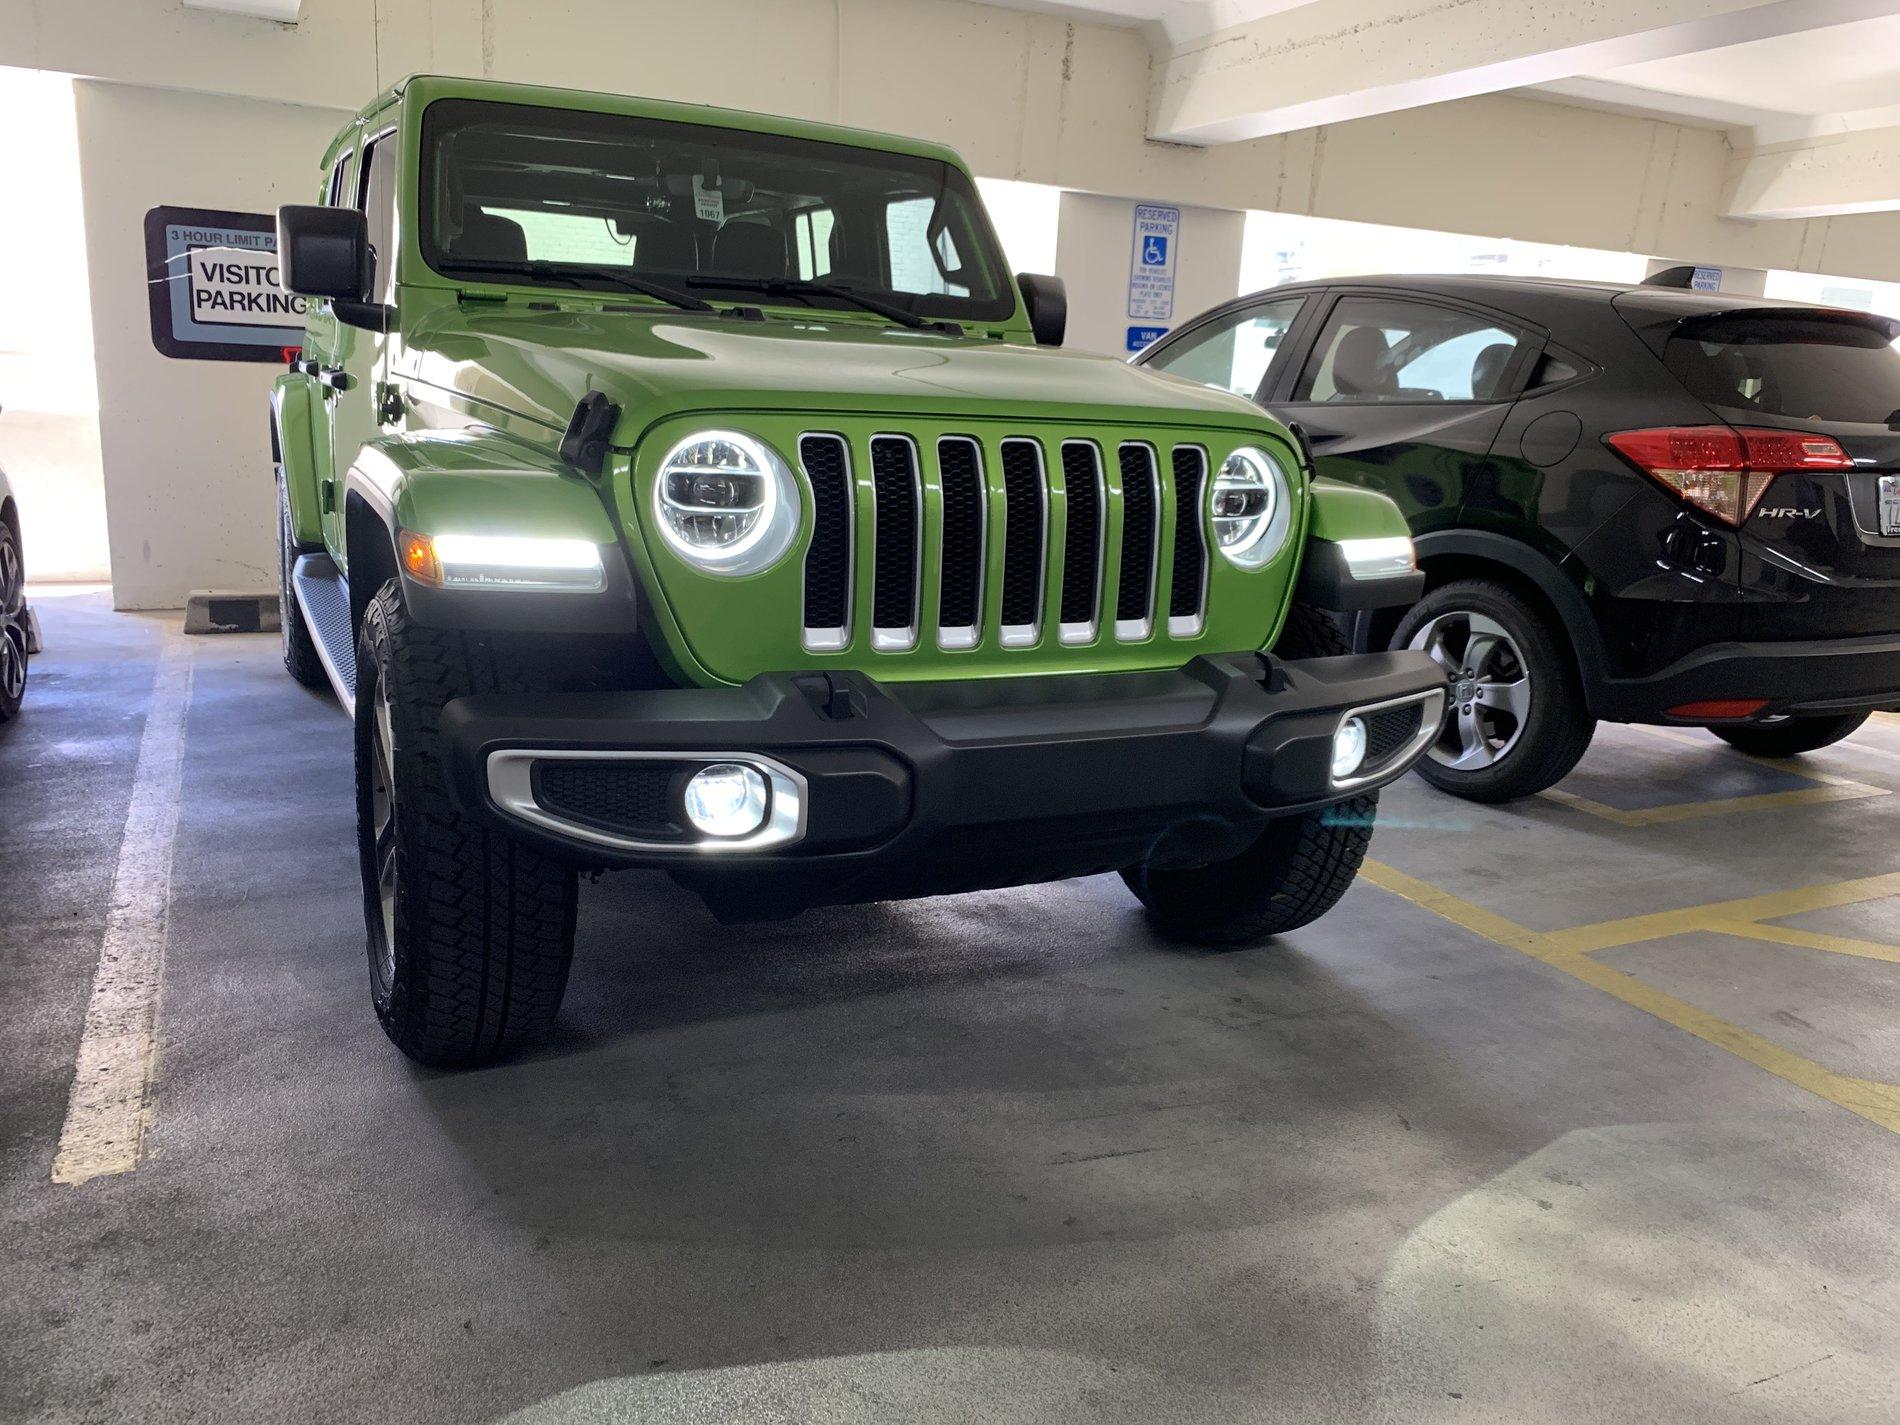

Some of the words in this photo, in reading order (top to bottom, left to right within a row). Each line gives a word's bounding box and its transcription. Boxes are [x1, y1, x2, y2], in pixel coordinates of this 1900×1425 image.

[700, 209, 720, 219] 1067
[1136, 208, 1178, 223] RESERVED
[1140, 221, 1173, 235] PARKING
[172, 230, 180, 241] 3
[183, 230, 223, 244] HOUR
[226, 234, 261, 247] LIMIT
[200, 262, 281, 287] VISITO
[196, 289, 307, 314] PARKING
[1141, 331, 1158, 341] VAN
[1758, 507, 1823, 519] HR-V
